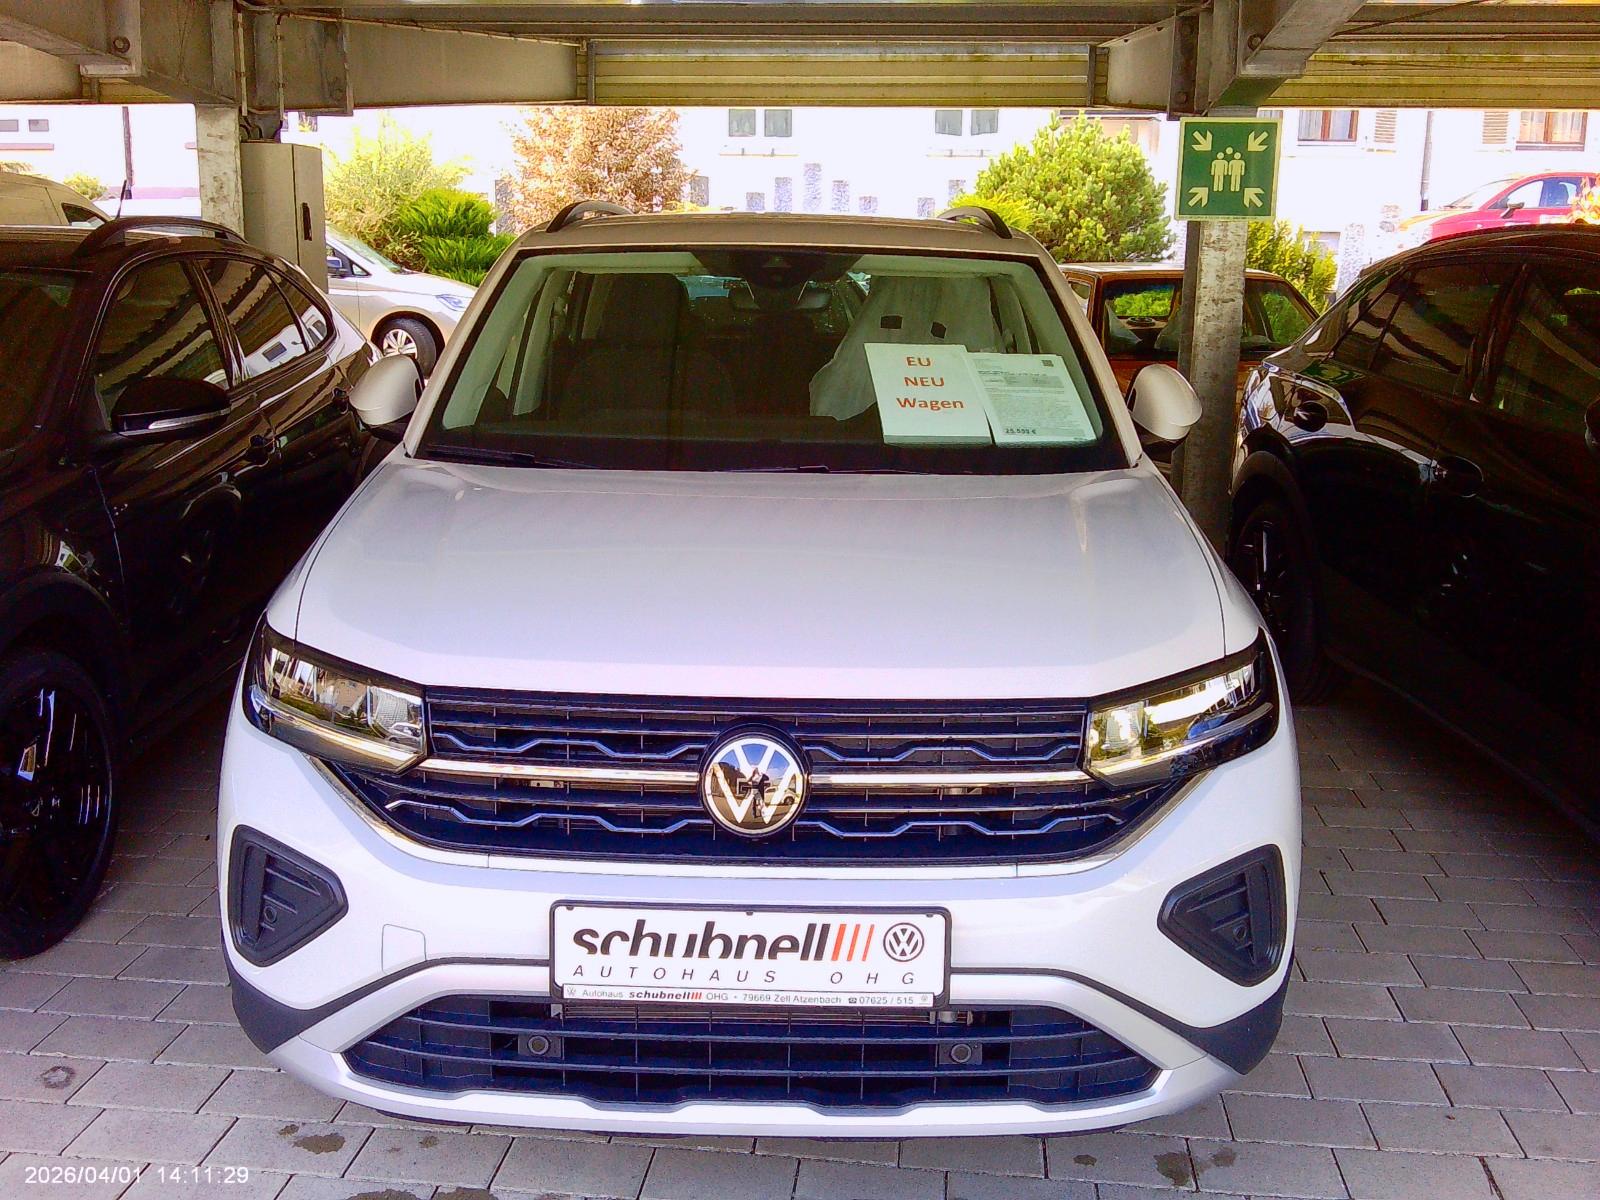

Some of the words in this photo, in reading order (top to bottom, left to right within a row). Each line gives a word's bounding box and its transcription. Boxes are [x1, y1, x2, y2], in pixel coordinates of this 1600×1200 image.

[906, 356, 931, 367] EU
[904, 376, 945, 387] NEU
[896, 397, 965, 411] Wagen
[573, 919, 832, 962] schubnell
[573, 964, 776, 983] AUTOHAUS
[829, 971, 915, 985] OHG
[582, 988, 624, 999] Autohaus
[629, 989, 691, 1000] schubnell
[705, 992, 729, 1001] OHG
[742, 993, 771, 1002] 79669
[774, 994, 791, 1003] Zell
[793, 994, 842, 1004] Atzenbach
[858, 996, 888, 1005] 07625
[896, 997, 914, 1005] 515
